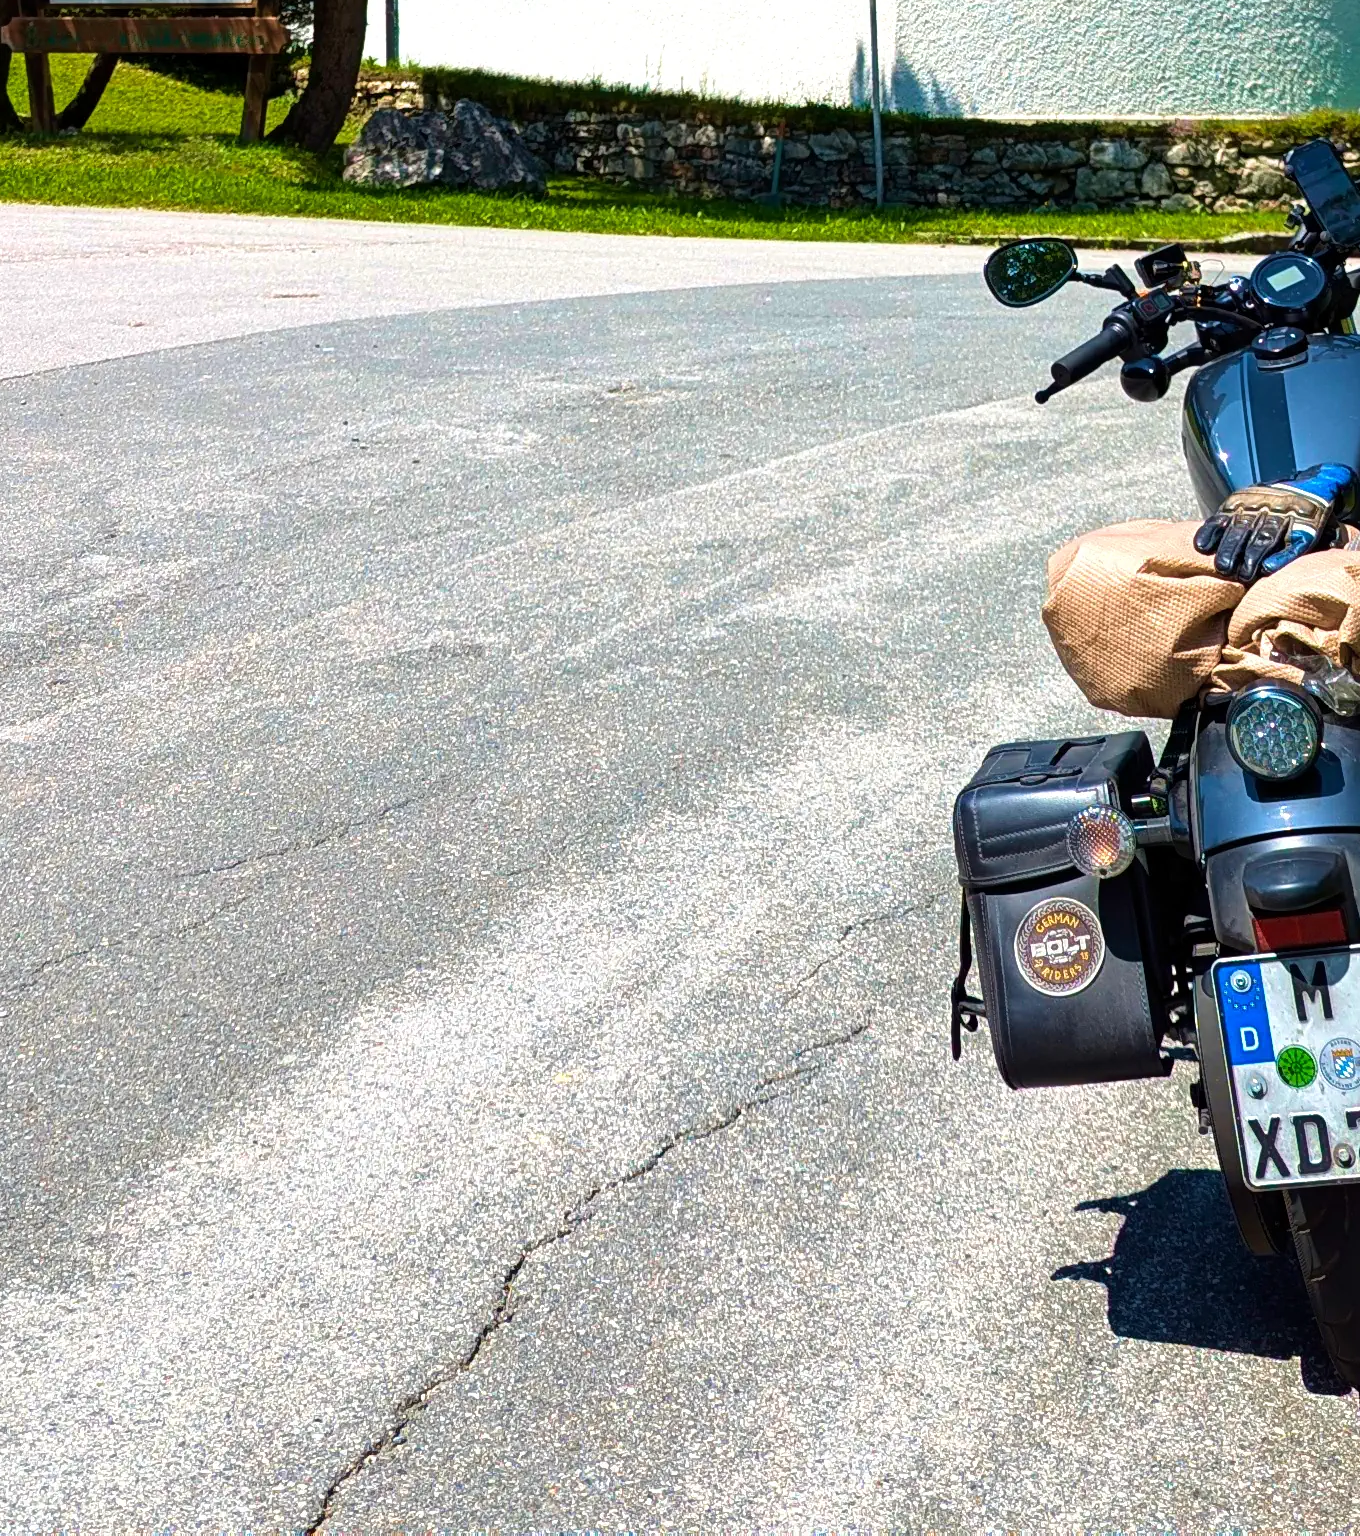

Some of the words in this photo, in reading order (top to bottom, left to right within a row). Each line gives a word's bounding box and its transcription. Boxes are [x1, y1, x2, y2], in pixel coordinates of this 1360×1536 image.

[1035, 913, 1079, 934] GERMAN
[1030, 934, 1091, 958] BOLT
[1041, 963, 1082, 981] RIDERS
[1290, 960, 1334, 1022] M
[1240, 1026, 1260, 1052] D
